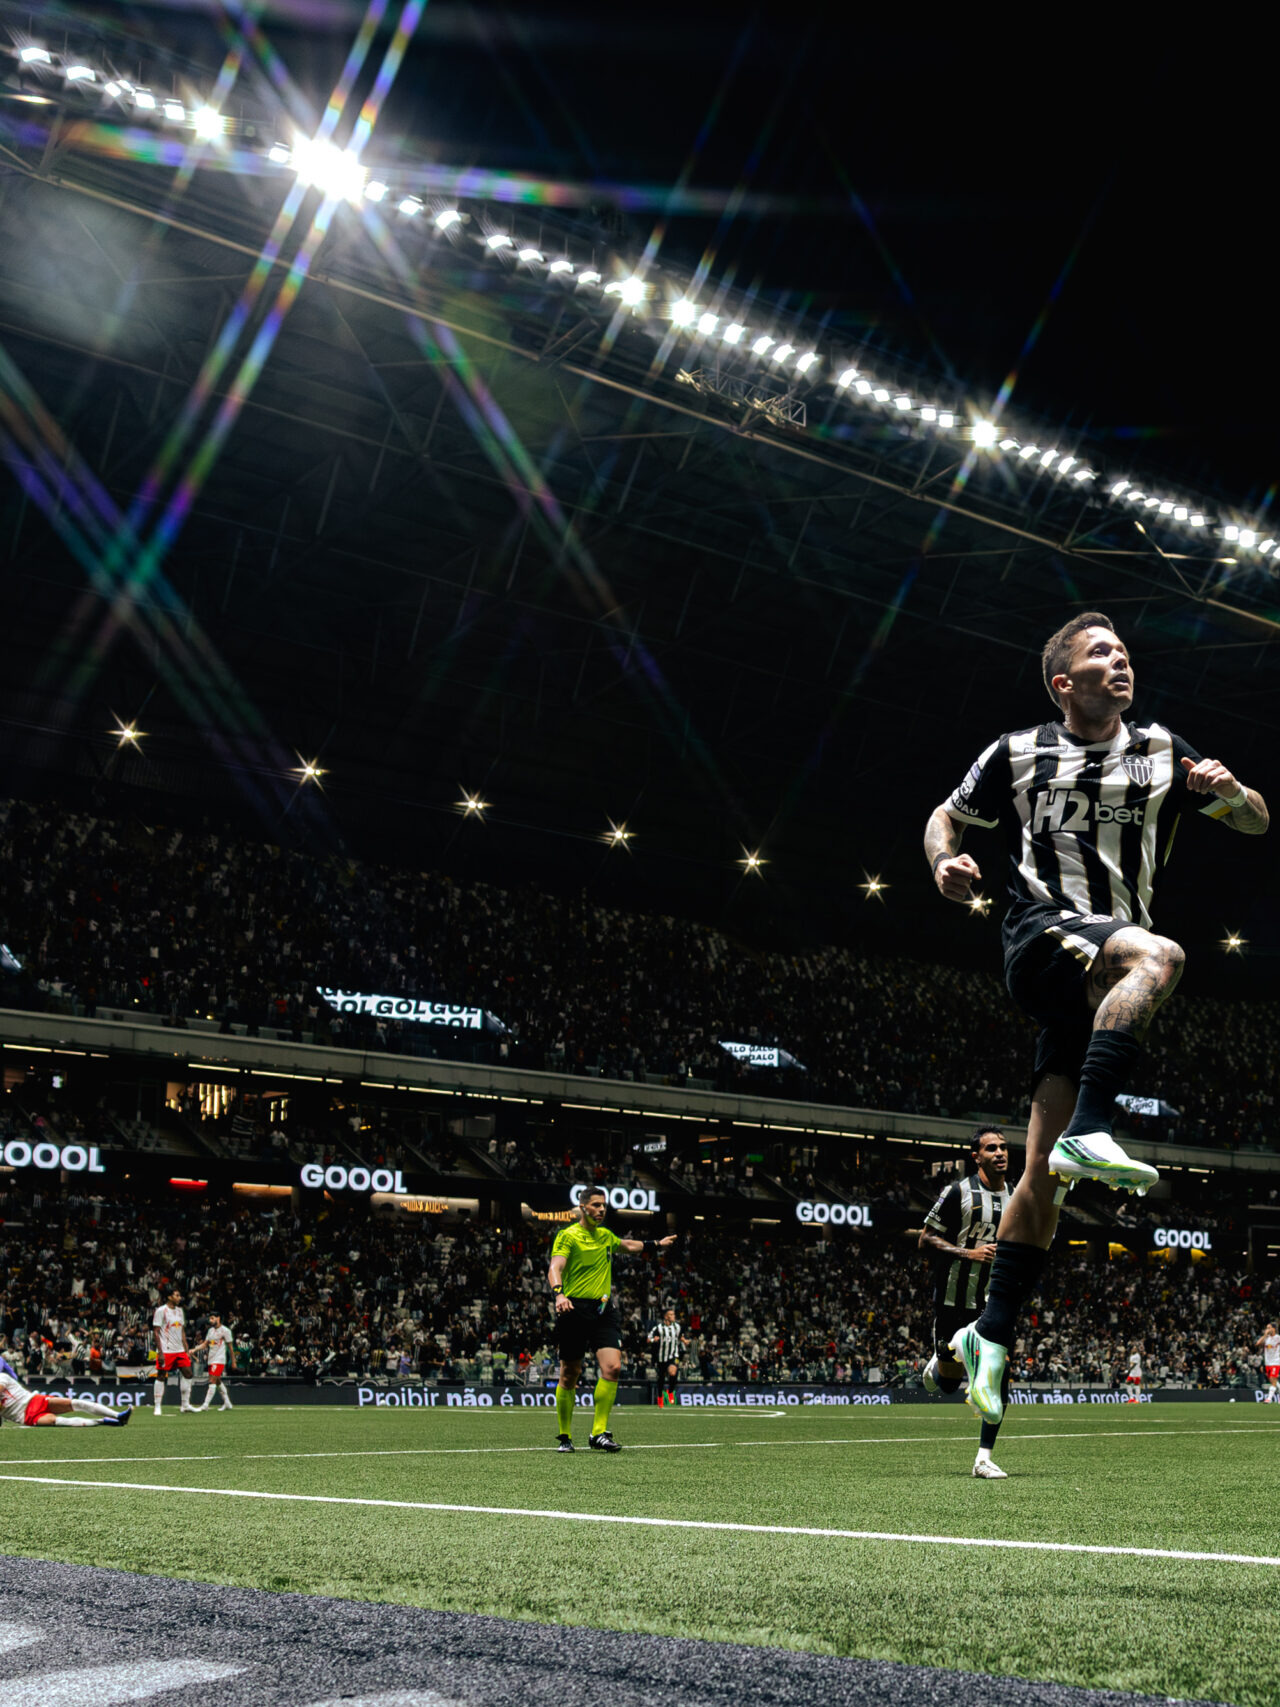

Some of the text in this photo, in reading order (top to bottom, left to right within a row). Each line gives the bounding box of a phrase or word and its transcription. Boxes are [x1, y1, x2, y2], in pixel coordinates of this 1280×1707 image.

[375, 999, 428, 1015] GOL
[0, 1140, 105, 1173] OOOL
[300, 1163, 408, 1194] GOOOL
[796, 1201, 873, 1227] GOOOL
[968, 1221, 997, 1242] H2
[1154, 1228, 1212, 1250] GOOOL
[357, 1387, 439, 1407] Proibir
[447, 1389, 493, 1407] não
[501, 1388, 513, 1407] é
[680, 1390, 799, 1406] BRASILEIRÃO
[852, 1394, 891, 1405] 2026
[1043, 1390, 1073, 1404] não
[1077, 1389, 1087, 1404] é
[1091, 1390, 1153, 1404] proteer
